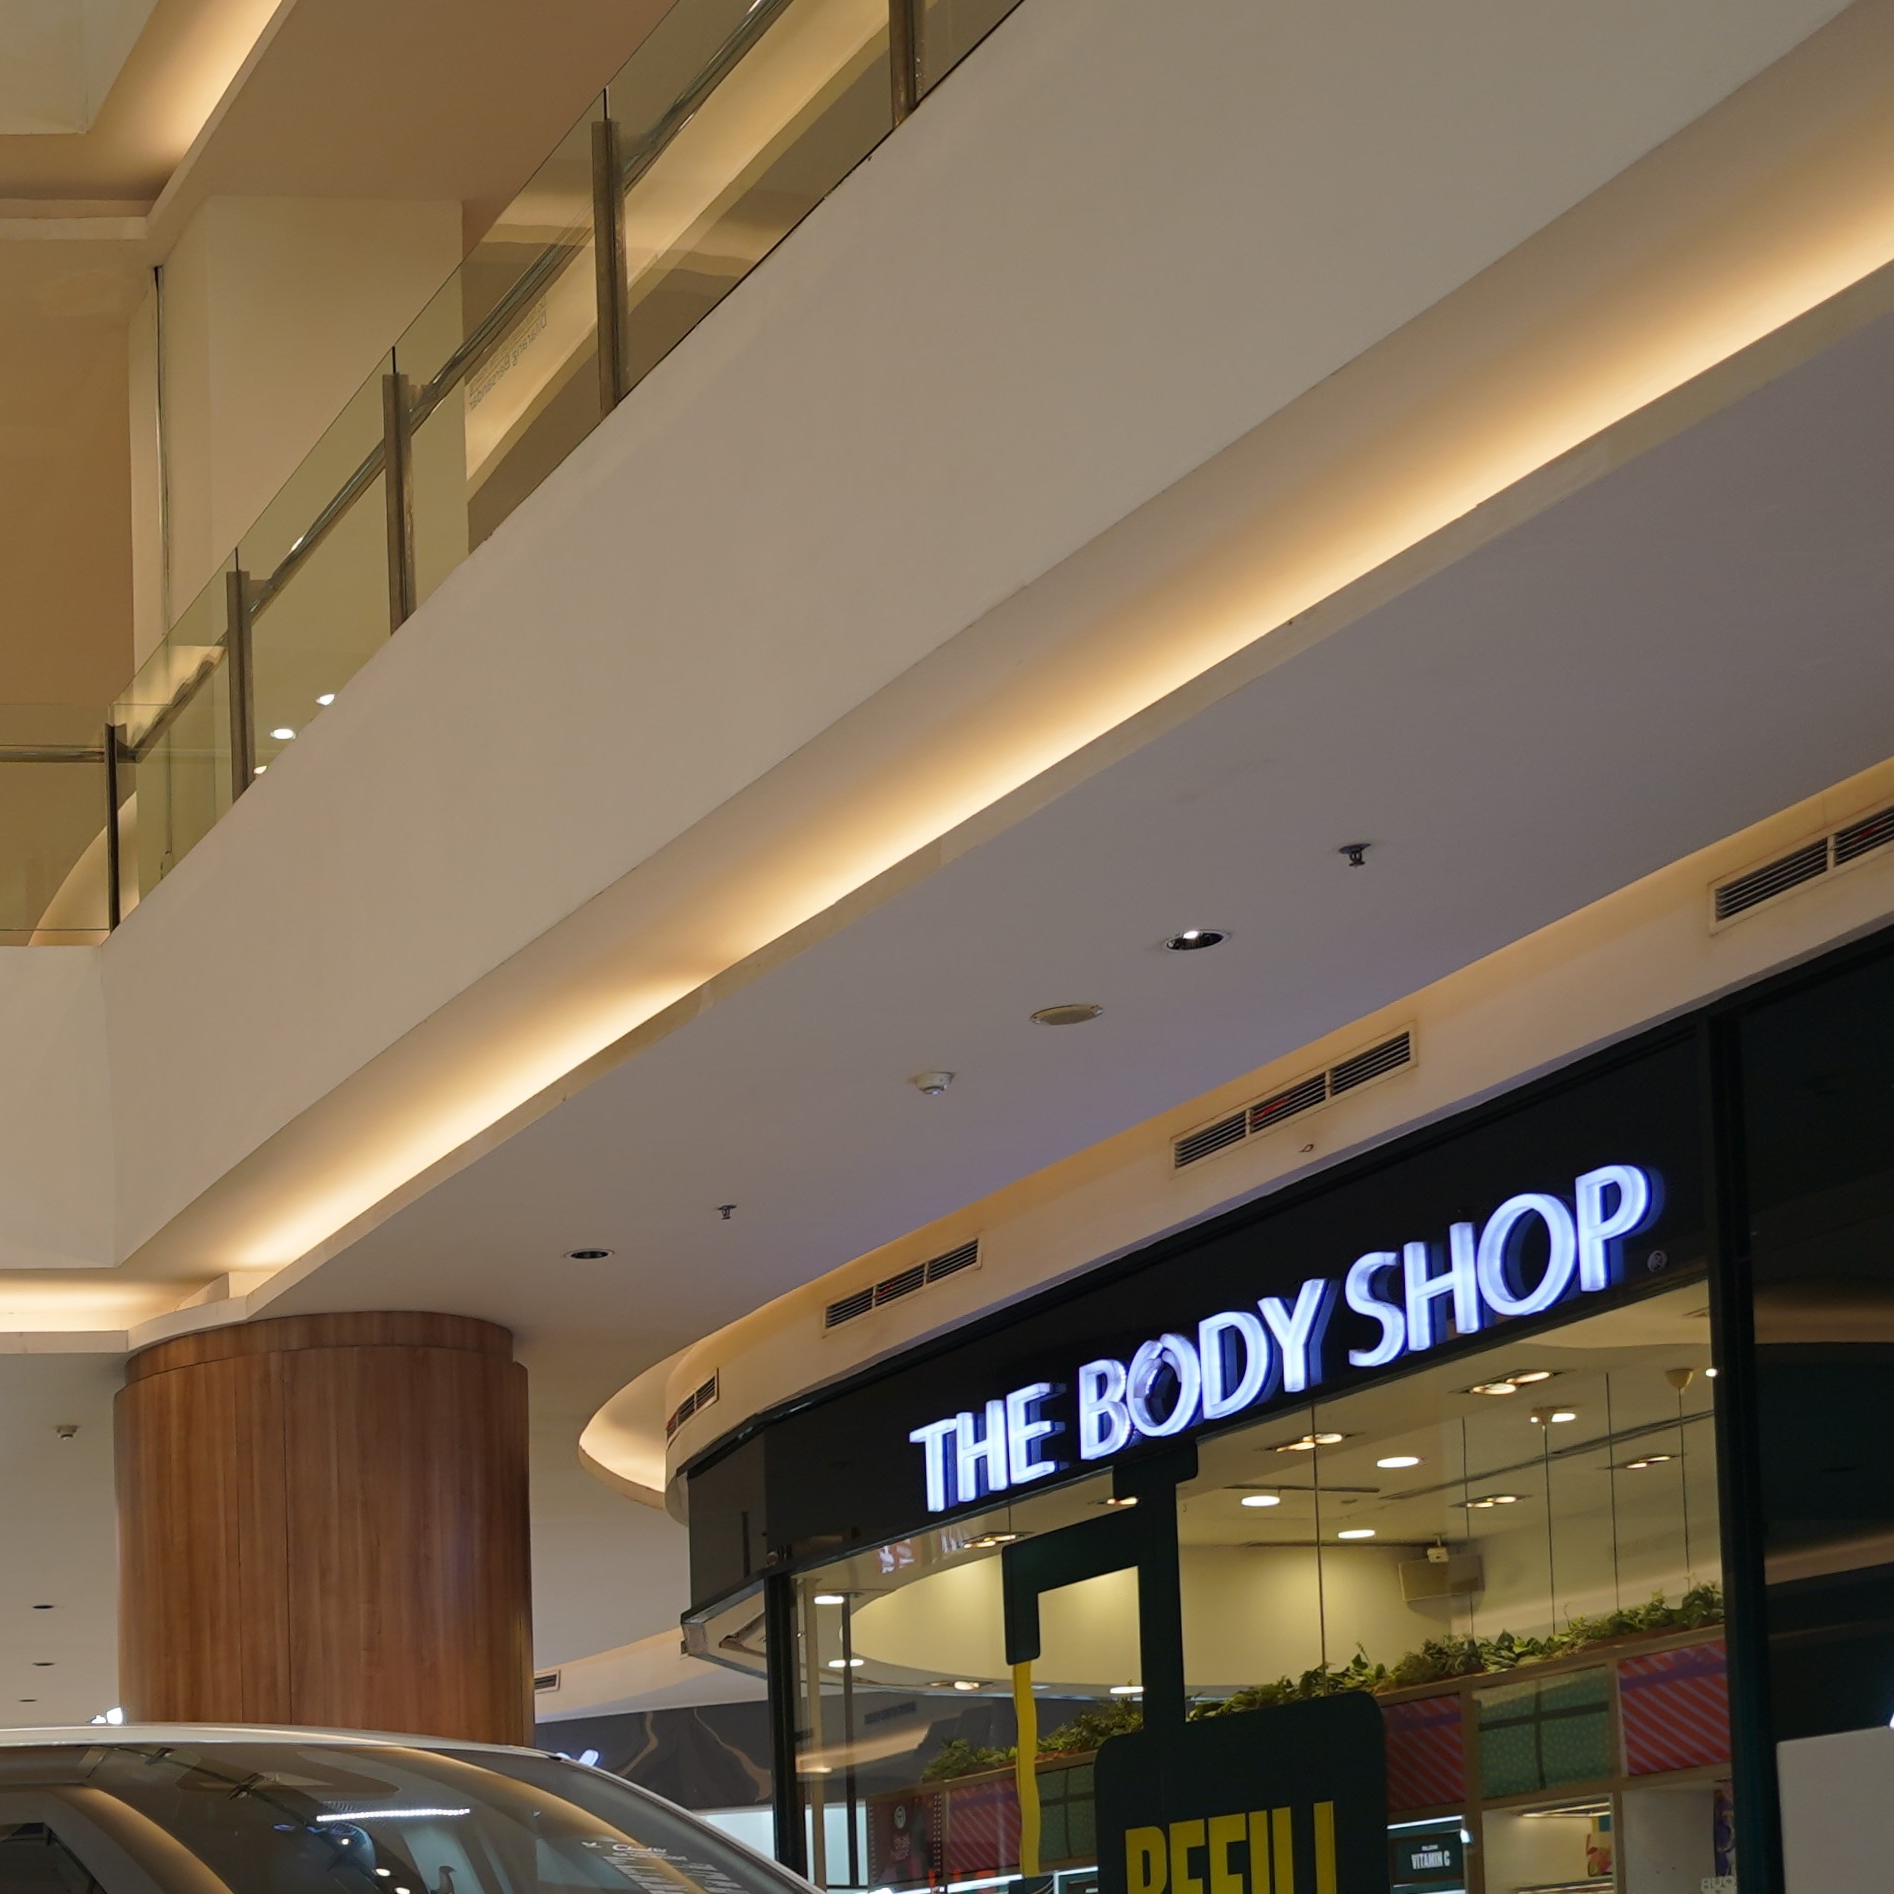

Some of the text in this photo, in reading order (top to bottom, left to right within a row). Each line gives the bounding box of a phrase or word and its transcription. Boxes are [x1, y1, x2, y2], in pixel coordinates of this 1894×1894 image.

[908, 1164, 1658, 1513] THE BODY SHOP
